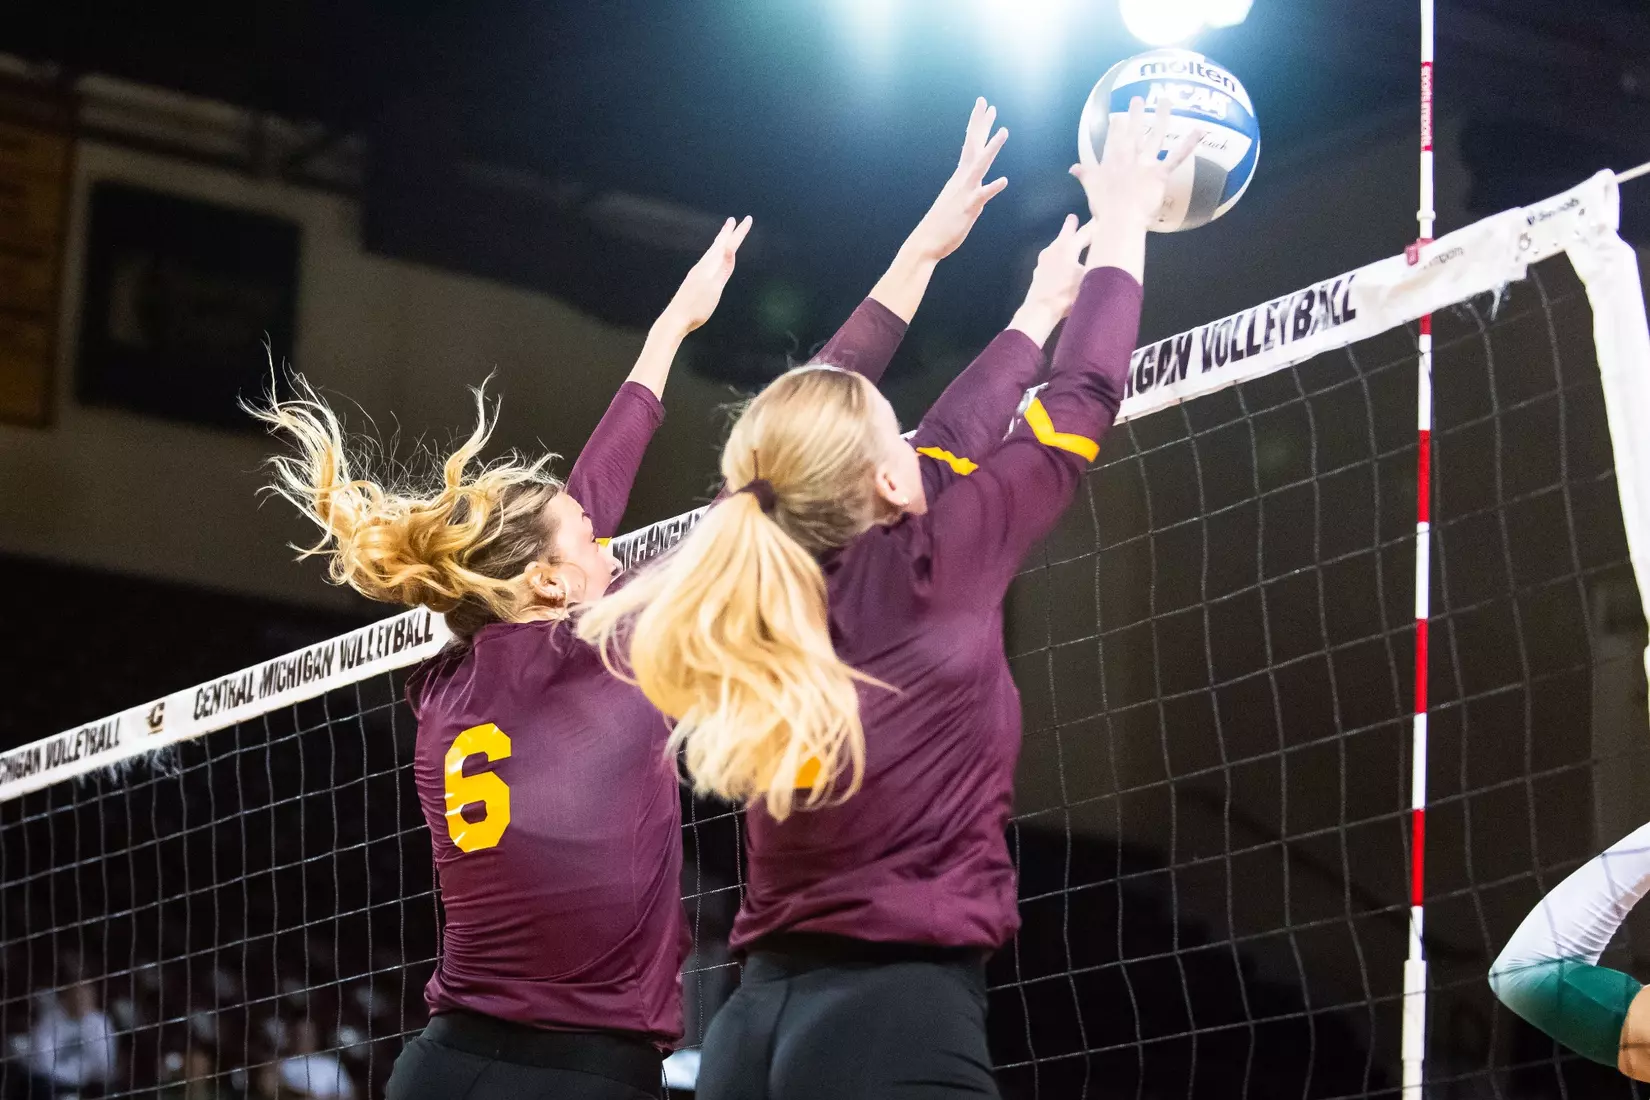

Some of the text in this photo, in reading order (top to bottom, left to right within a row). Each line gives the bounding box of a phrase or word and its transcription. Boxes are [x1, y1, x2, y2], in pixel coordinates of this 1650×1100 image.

[1140, 60, 1236, 92] molten
[1200, 274, 1356, 374] VOLLEYBALL
[193, 611, 434, 720] CENTRAL MICHIGAN VOLLEYBALL
[44, 717, 121, 770] VOLLEYBALL
[444, 722, 511, 853] 6
